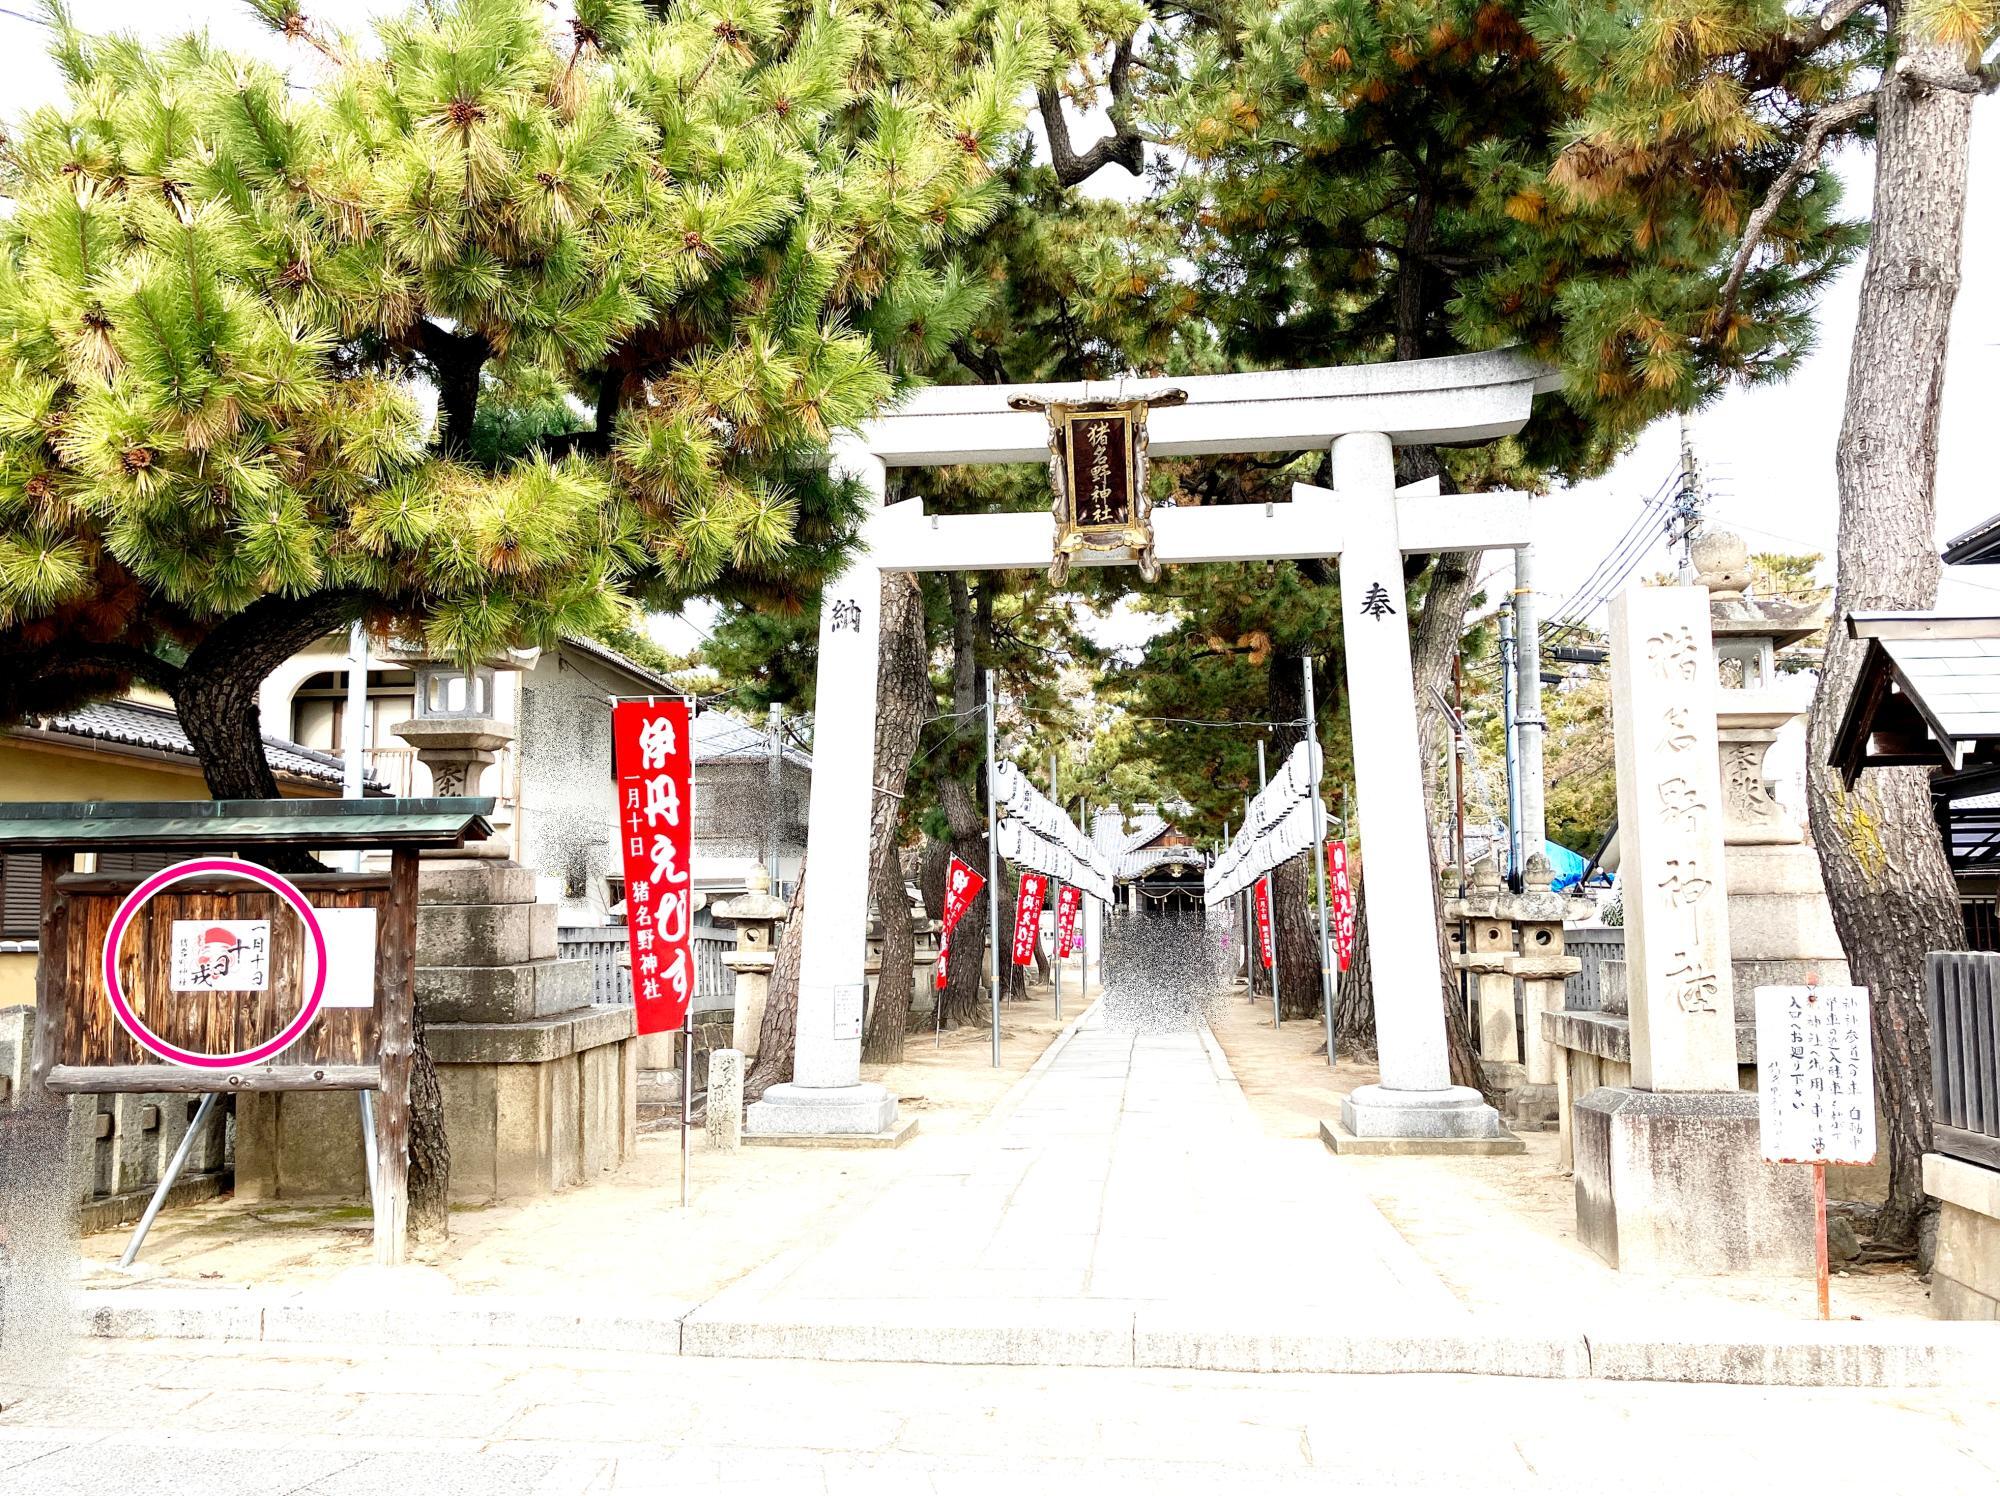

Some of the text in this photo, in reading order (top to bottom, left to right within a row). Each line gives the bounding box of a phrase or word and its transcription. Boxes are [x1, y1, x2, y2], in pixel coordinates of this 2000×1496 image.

[1087, 420, 1114, 523] 猪名野神社
[831, 599, 862, 633] 納
[1360, 582, 1396, 622] 奉
[434, 764, 463, 796] 奉
[623, 775, 645, 857] 一月十日
[638, 716, 689, 1003] 伊丹えびす
[250, 925, 267, 986] 一月十日
[631, 880, 663, 1000] 猪名野神社
